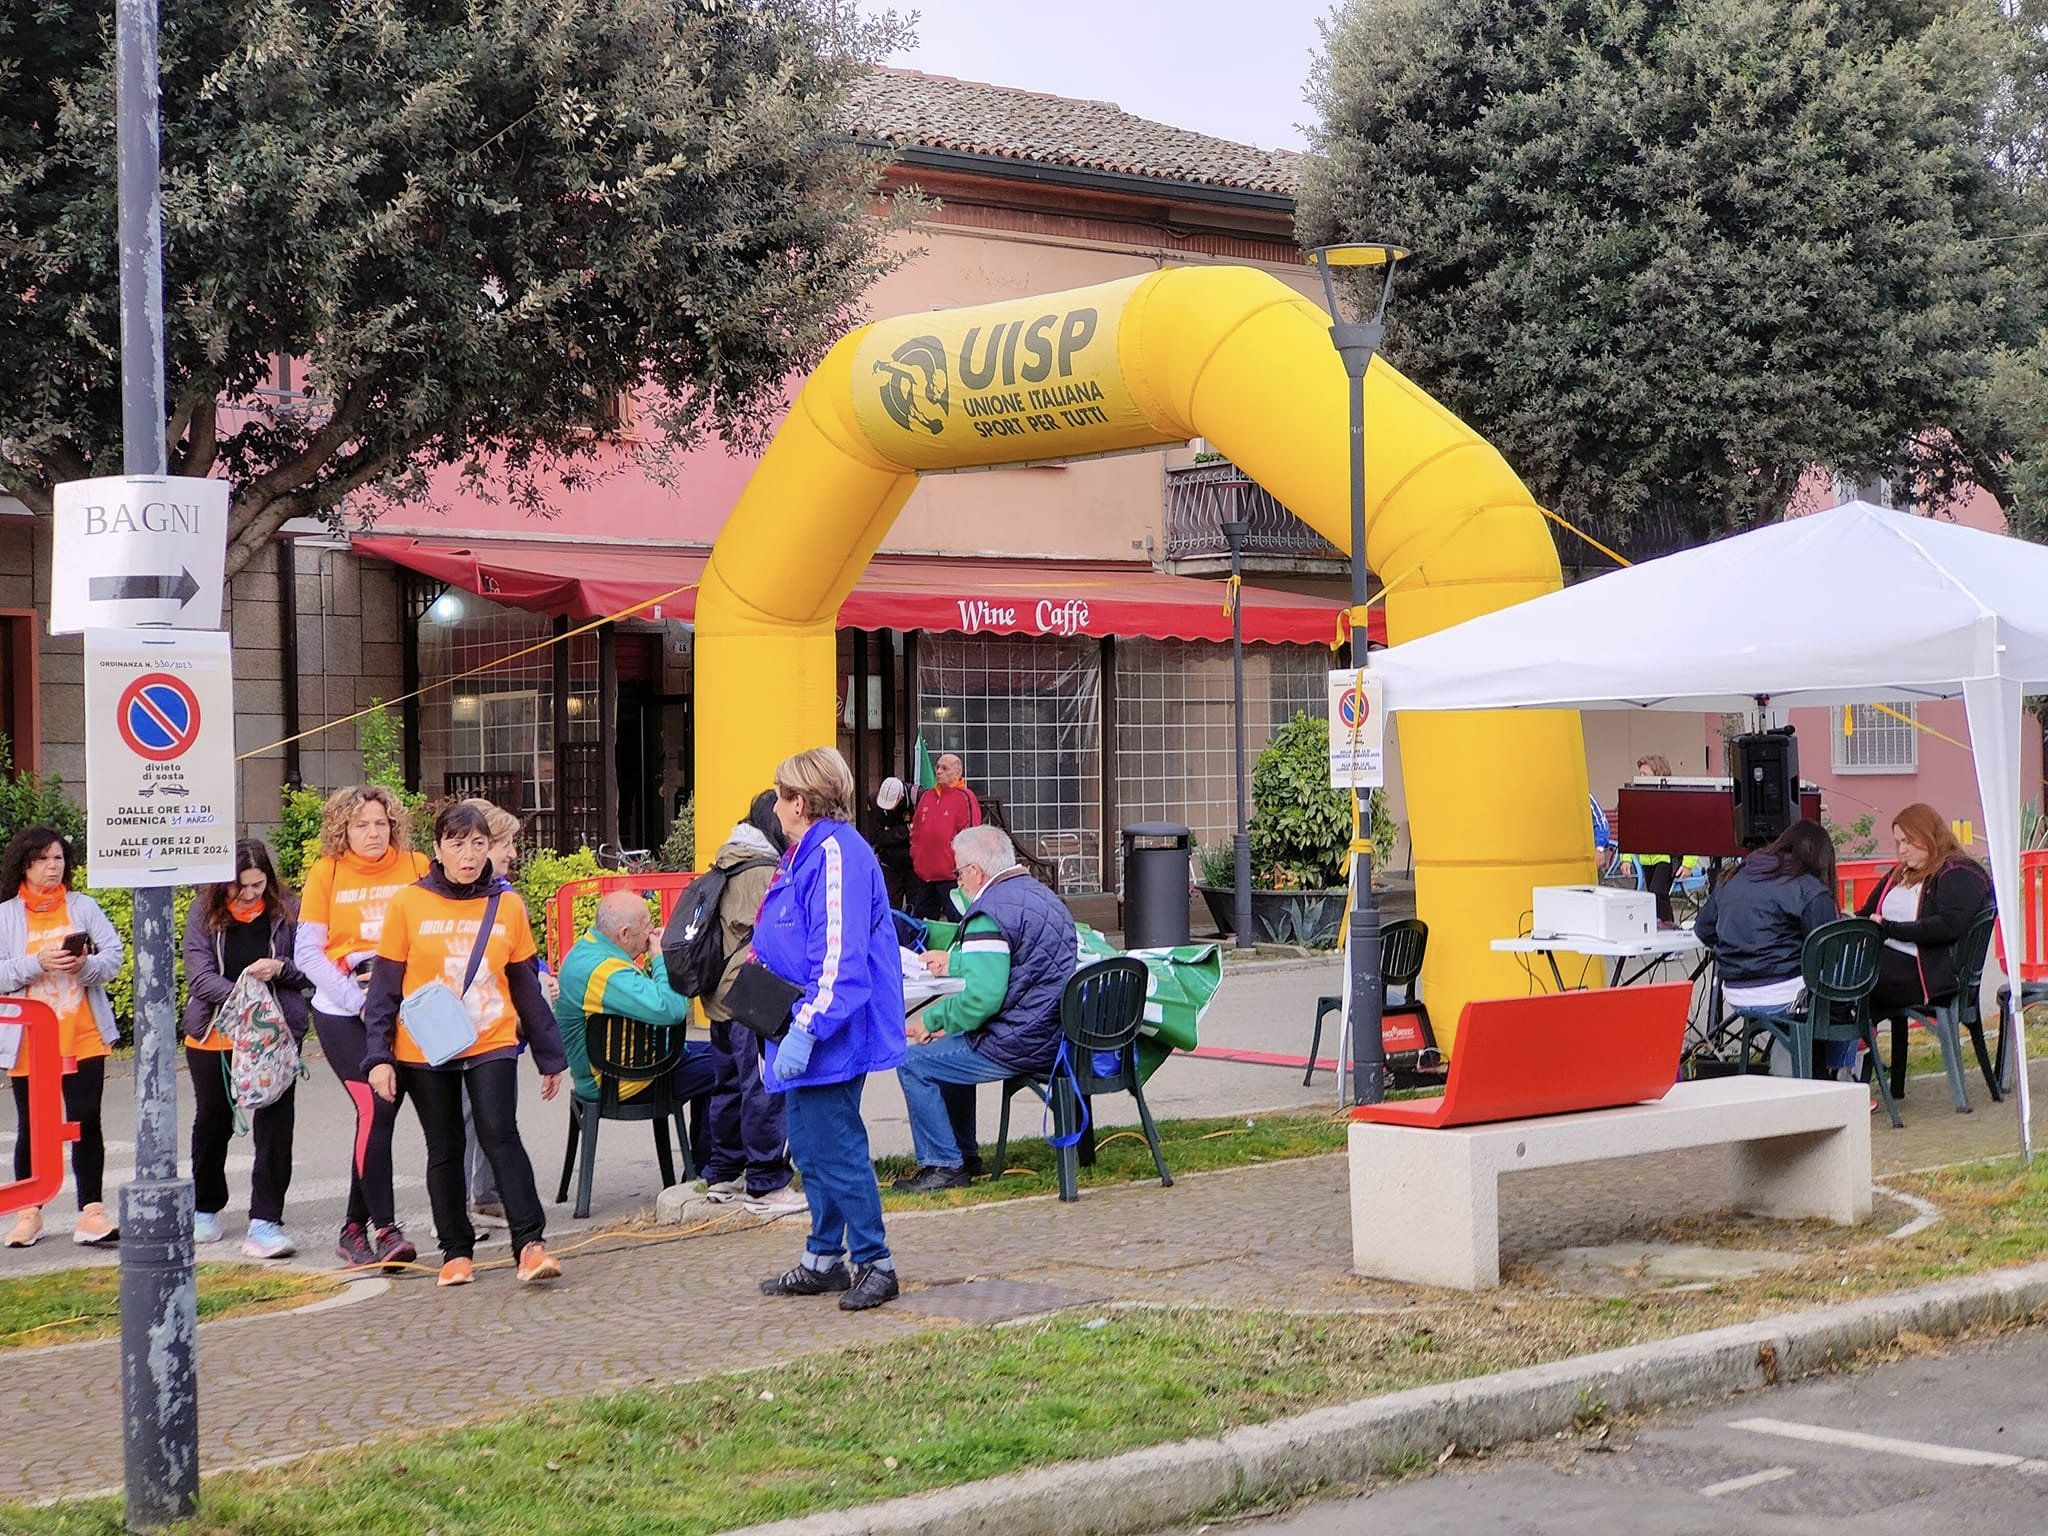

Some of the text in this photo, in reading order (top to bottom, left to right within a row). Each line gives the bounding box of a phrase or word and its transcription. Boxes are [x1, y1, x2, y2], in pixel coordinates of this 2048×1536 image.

[959, 307, 1098, 390] UISP
[962, 381, 1105, 418] UNIONE ITALIANA
[973, 405, 1108, 438] SPORT PER TUTTI
[84, 502, 201, 536] BAGNI
[956, 600, 1090, 636] Wine Caffè
[99, 660, 143, 668] ORDINANZA
[145, 763, 181, 771] divieto
[142, 772, 152, 781] di
[118, 805, 211, 815] DALLE ORE 12 DI
[106, 817, 167, 826] DOMENICA
[120, 836, 205, 846] ALLE ORE 12 DI
[160, 847, 200, 856] APRILE
[203, 845, 229, 855] 2024
[335, 887, 367, 904] IMOLA
[418, 919, 454, 936] IMOLA
